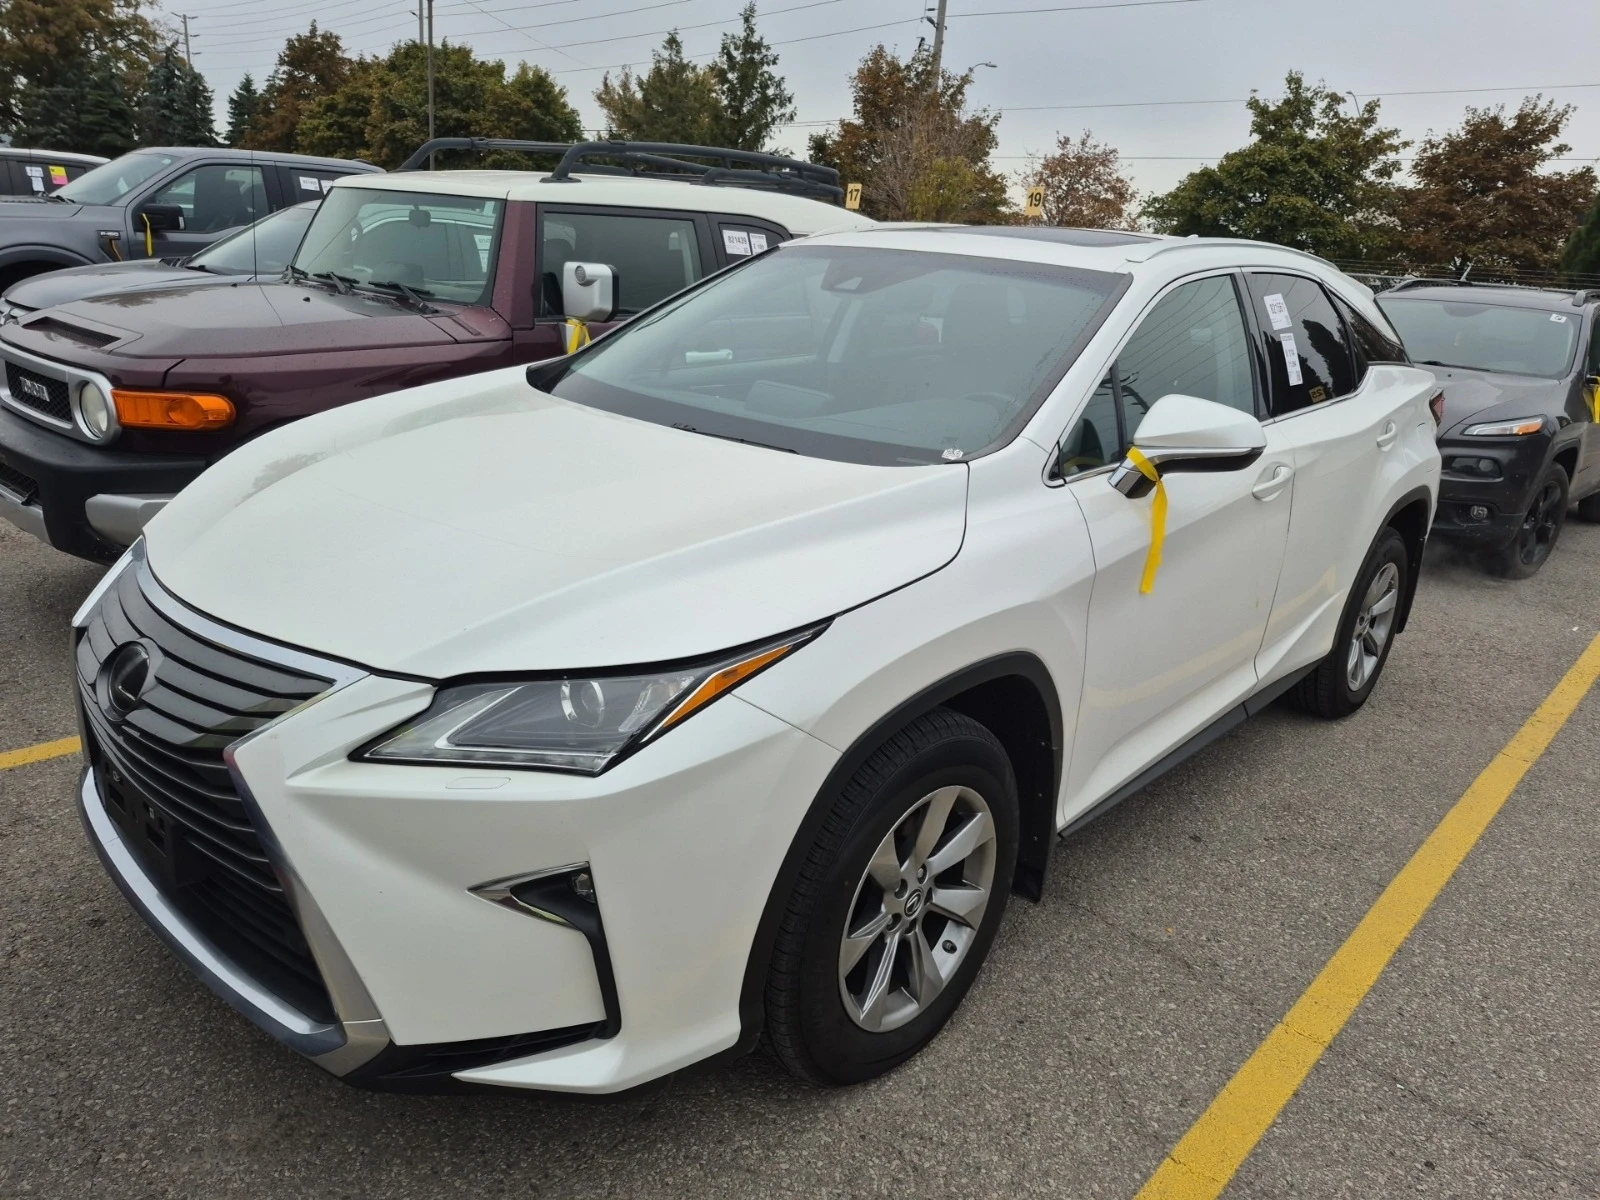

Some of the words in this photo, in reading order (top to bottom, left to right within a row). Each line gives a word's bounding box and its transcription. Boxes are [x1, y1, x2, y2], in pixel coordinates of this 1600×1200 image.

[848, 188, 860, 202] 17
[1028, 192, 1042, 207] 19
[728, 236, 747, 245] 821439
[19, 376, 50, 402] TOYOTA
